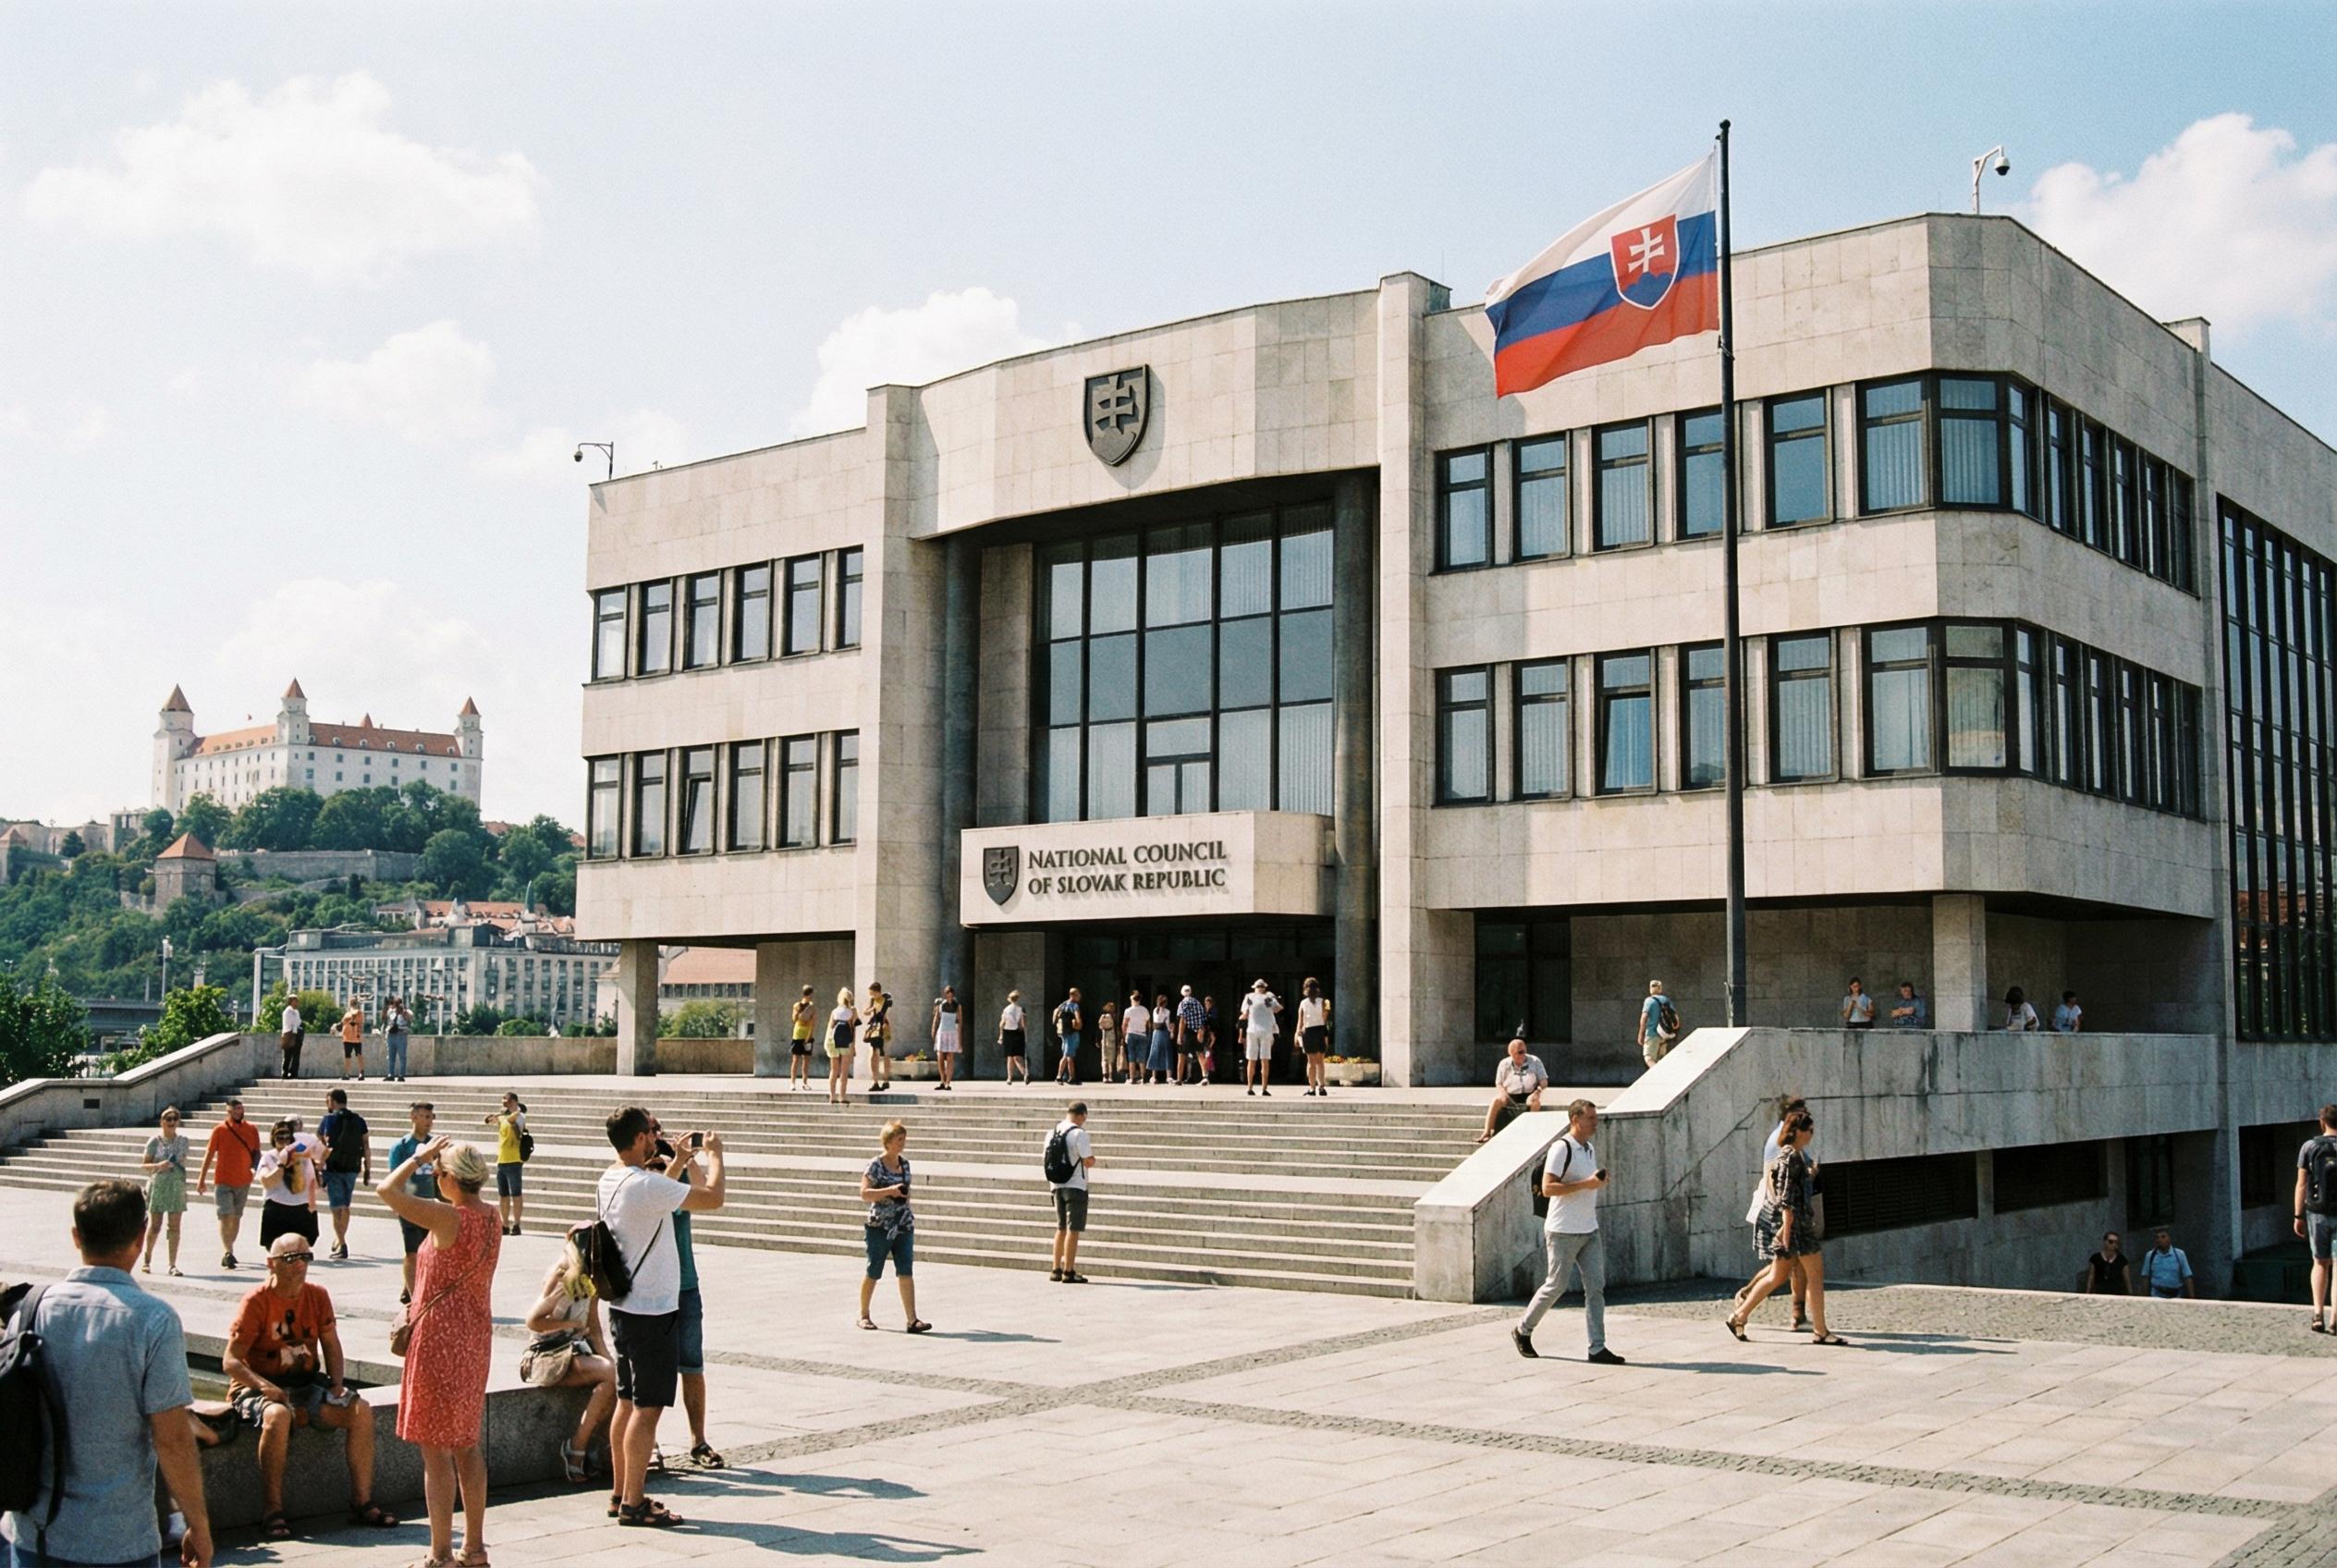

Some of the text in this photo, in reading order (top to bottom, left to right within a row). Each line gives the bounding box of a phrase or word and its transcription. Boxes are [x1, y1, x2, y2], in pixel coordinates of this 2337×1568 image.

[1028, 840, 1227, 869] NATIONAL COUNCIL
[1028, 868, 1226, 895] OF SLOVAK REPUBLIC
